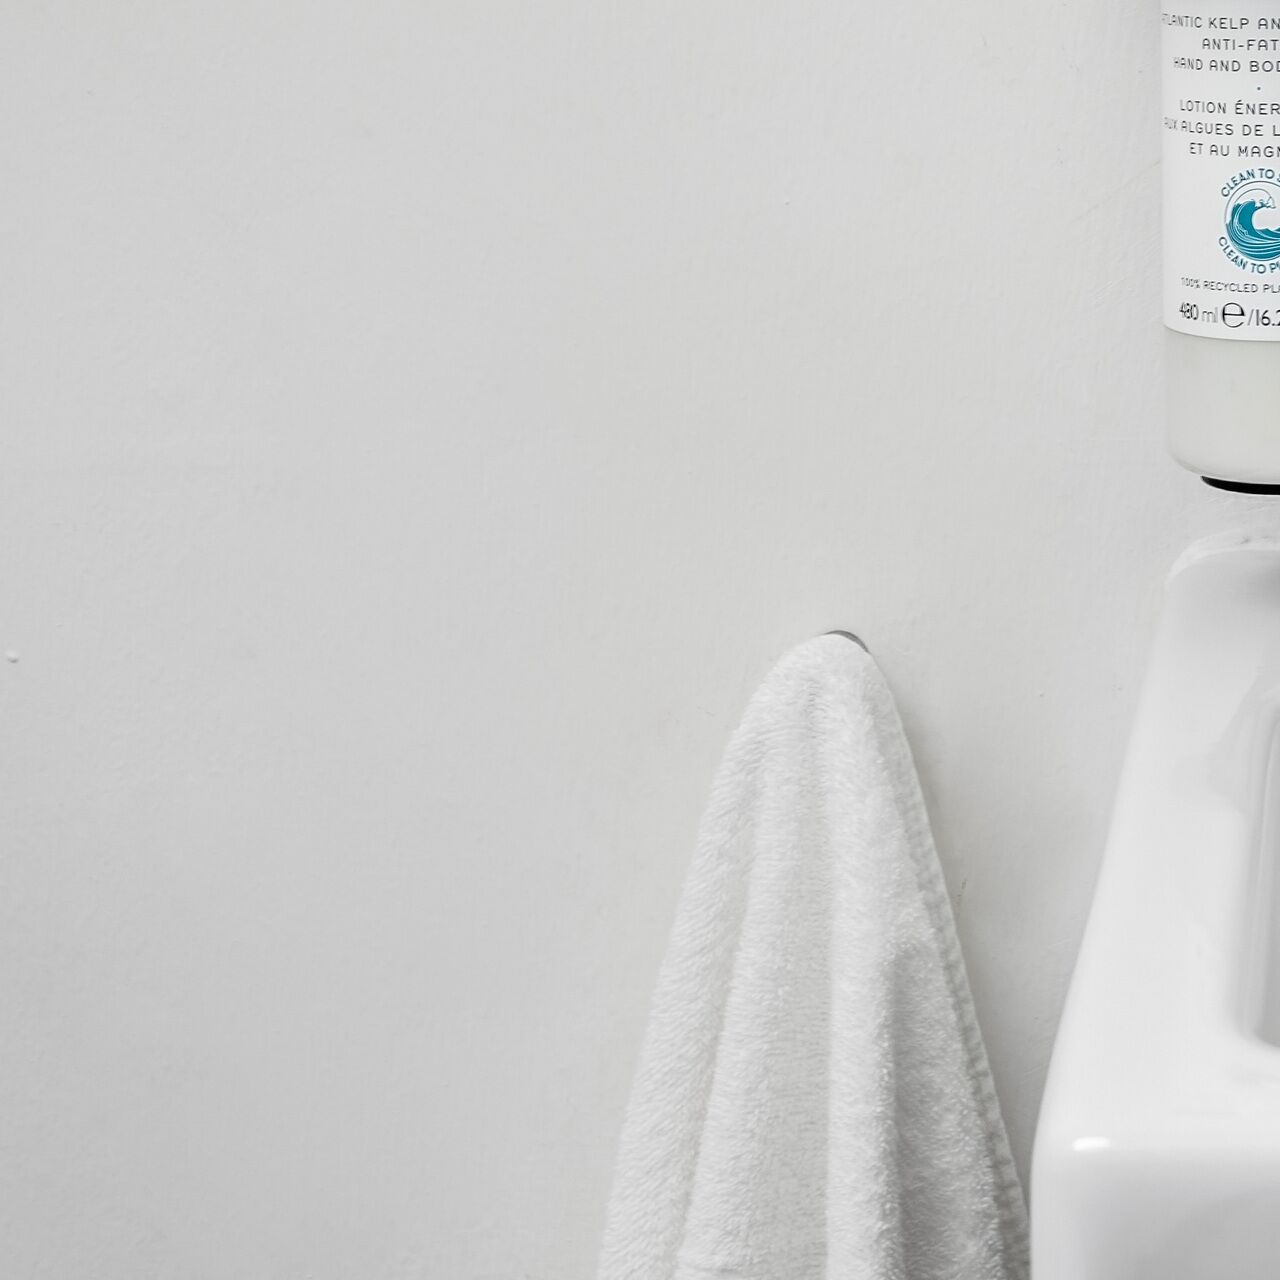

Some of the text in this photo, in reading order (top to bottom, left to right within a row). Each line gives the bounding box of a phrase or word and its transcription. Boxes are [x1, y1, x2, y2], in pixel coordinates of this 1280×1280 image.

[1209, 18, 1249, 29] KELP
[1174, 58, 1203, 70] HAND
[1210, 60, 1240, 72] AND
[1181, 100, 1226, 114] LOTION
[1182, 121, 1233, 135] ALGUES
[1242, 124, 1263, 136] DE
[1190, 142, 1203, 154] ET
[1210, 144, 1229, 156] AU
[1221, 170, 1255, 197] CLEAN
[1258, 168, 1275, 180] TO
[1218, 236, 1247, 270] CLEAN
[1251, 262, 1267, 274] TO
[1204, 281, 1258, 293] RECYCLED
[1179, 303, 1199, 320] 480
[1202, 307, 1217, 322] ml
